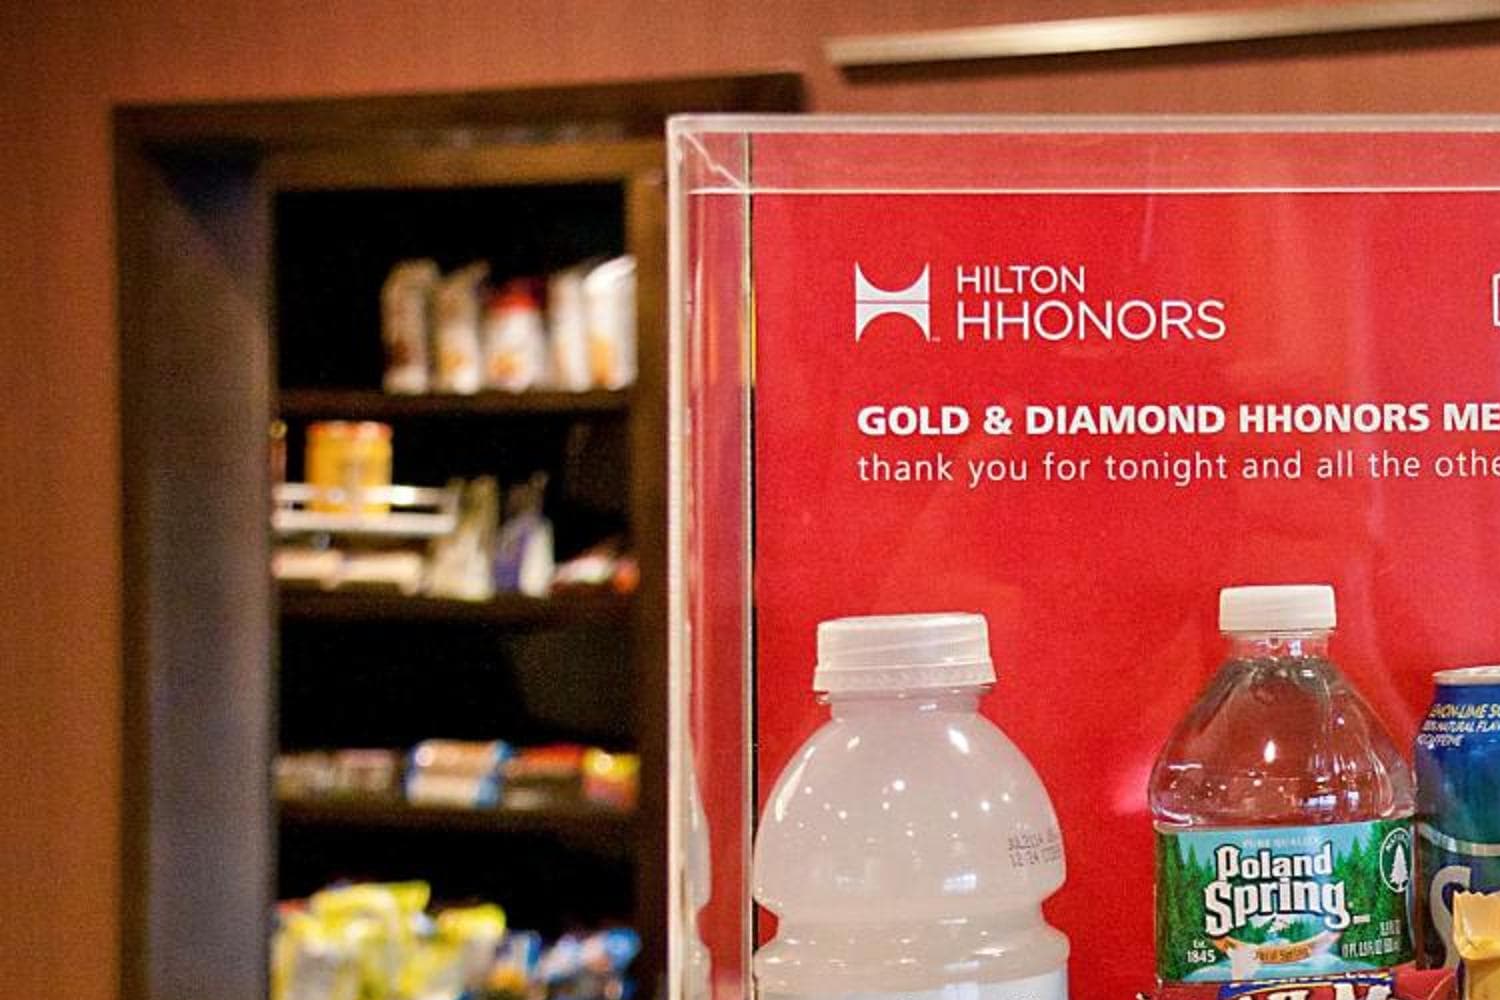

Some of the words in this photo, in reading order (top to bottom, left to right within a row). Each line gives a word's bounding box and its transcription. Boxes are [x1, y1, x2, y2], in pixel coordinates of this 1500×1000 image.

[956, 265, 1085, 294] HILTON
[956, 299, 1226, 341] HHONORS
[857, 405, 970, 435] GOLD
[983, 405, 1013, 435] &
[1026, 404, 1225, 434] DIAMOND
[1239, 403, 1430, 433] HHONORS
[857, 452, 954, 481] thank
[968, 457, 1028, 488] you
[1042, 451, 1091, 481] for
[1105, 450, 1228, 487] tonight
[1242, 450, 1302, 480] and
[1316, 449, 1354, 478] all
[1368, 449, 1421, 478] the
[1215, 841, 1333, 882] Poland
[1204, 877, 1351, 937] Spring
[1187, 949, 1217, 964] 1845
